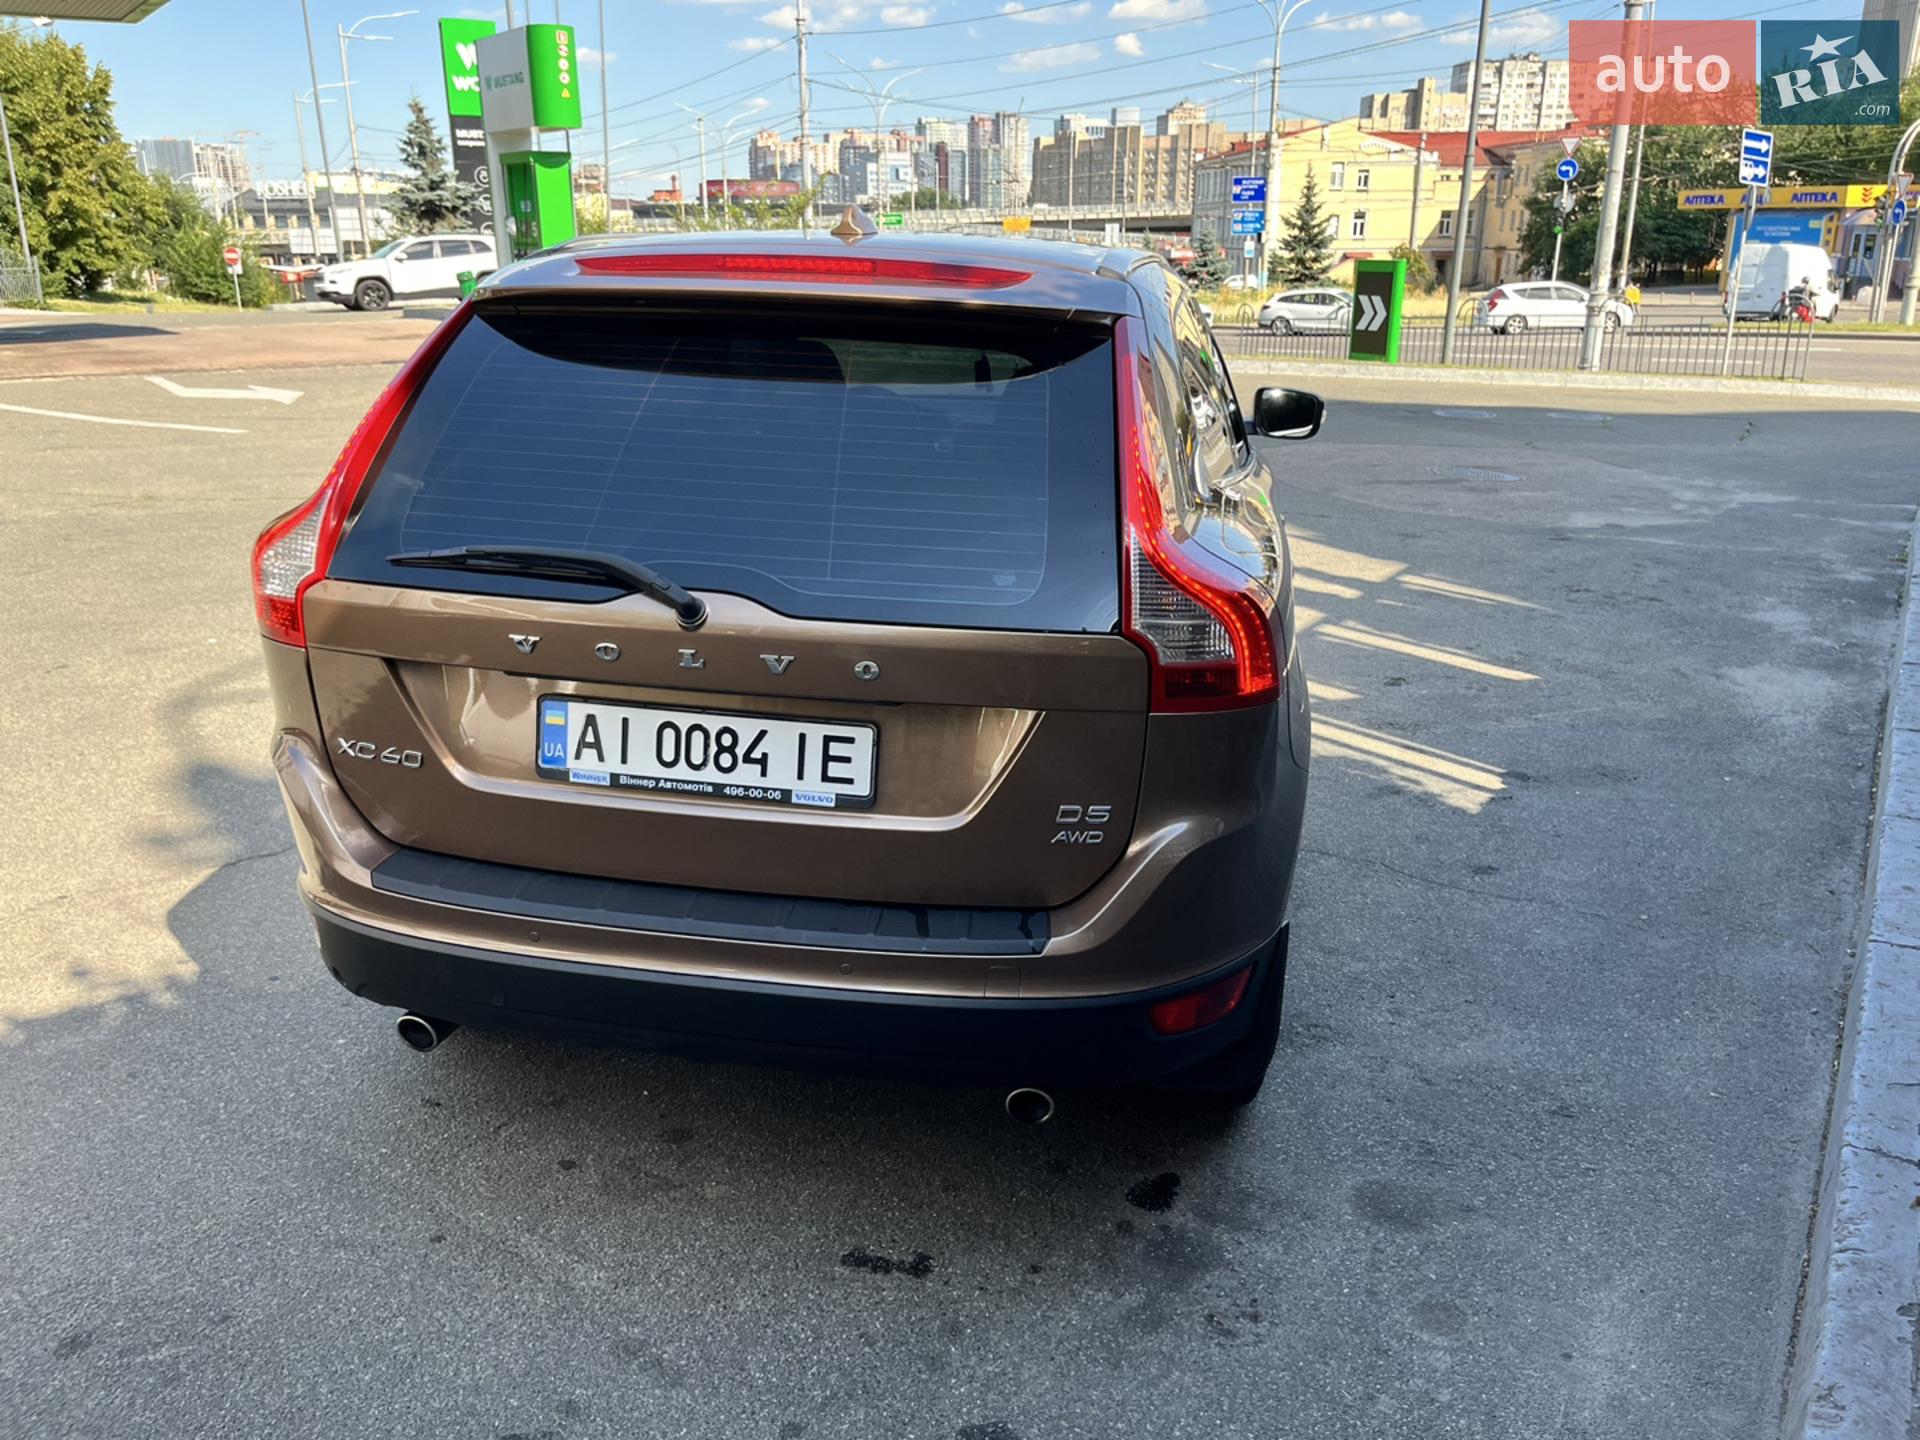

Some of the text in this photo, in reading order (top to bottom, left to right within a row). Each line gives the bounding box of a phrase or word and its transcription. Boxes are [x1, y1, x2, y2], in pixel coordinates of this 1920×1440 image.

[1684, 194, 1725, 206] АПТЕКА
[1790, 191, 1838, 204] АПТЕКА
[508, 633, 880, 681] VOLVO
[544, 742, 565, 758] UA
[574, 713, 856, 785] AI 0084 IE
[619, 775, 782, 800] Віннер Автомотів 496-00-06
[794, 793, 834, 804] VOLVO
[1055, 805, 1112, 824] D5
[1050, 830, 1104, 844] AWD
